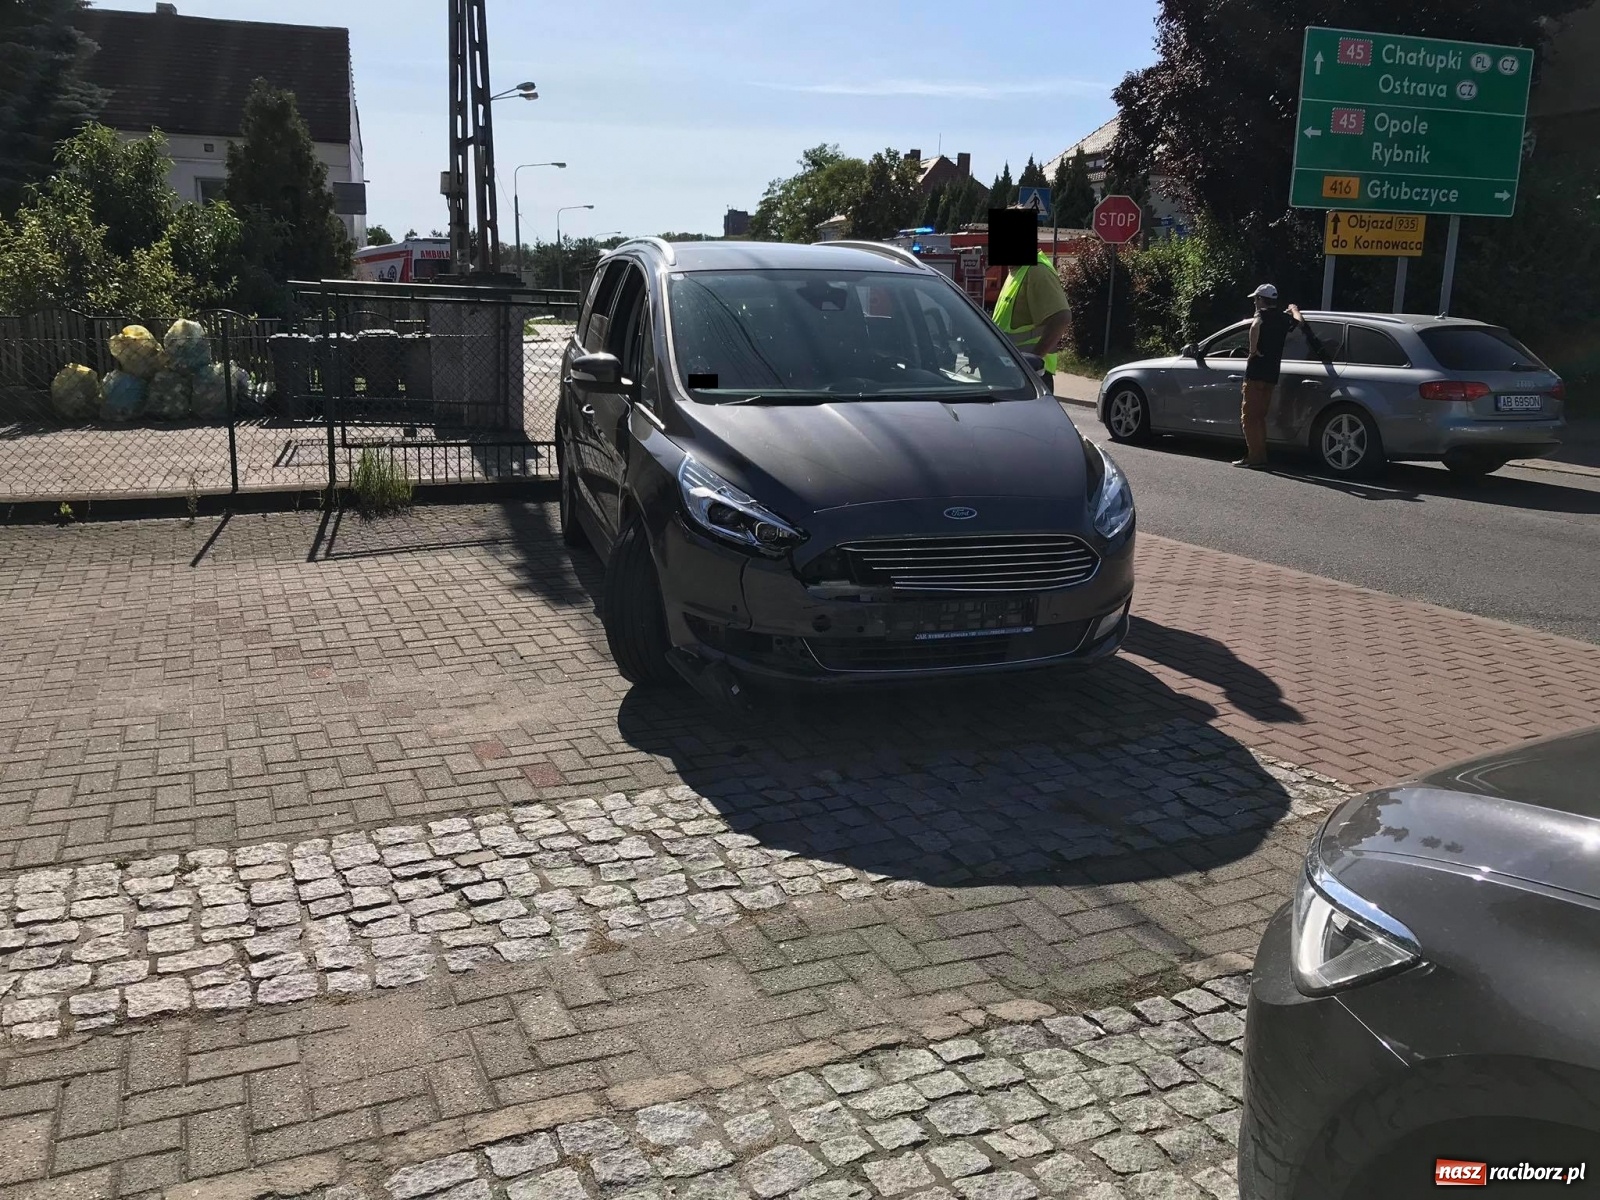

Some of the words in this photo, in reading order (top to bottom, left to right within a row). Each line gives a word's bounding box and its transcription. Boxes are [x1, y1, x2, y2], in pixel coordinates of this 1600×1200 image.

[1346, 44, 1365, 60] 45
[1381, 44, 1463, 73] Chałupki
[1474, 56, 1487, 69] PL
[1501, 59, 1516, 72] CZ
[1378, 74, 1448, 98] Ostrava
[1459, 84, 1474, 97] CZ
[1339, 114, 1357, 129] 45
[1374, 112, 1429, 138] Opole
[1371, 142, 1431, 167] Rybnik
[1329, 180, 1352, 195] 416
[1366, 179, 1459, 207] Głubczyce
[1099, 212, 1136, 227] STOP
[1347, 214, 1394, 233] Objazd
[1397, 219, 1416, 230] 935
[1331, 233, 1348, 249] do
[1353, 235, 1423, 251] Kornowaca
[420, 251, 450, 259] AMBULA
